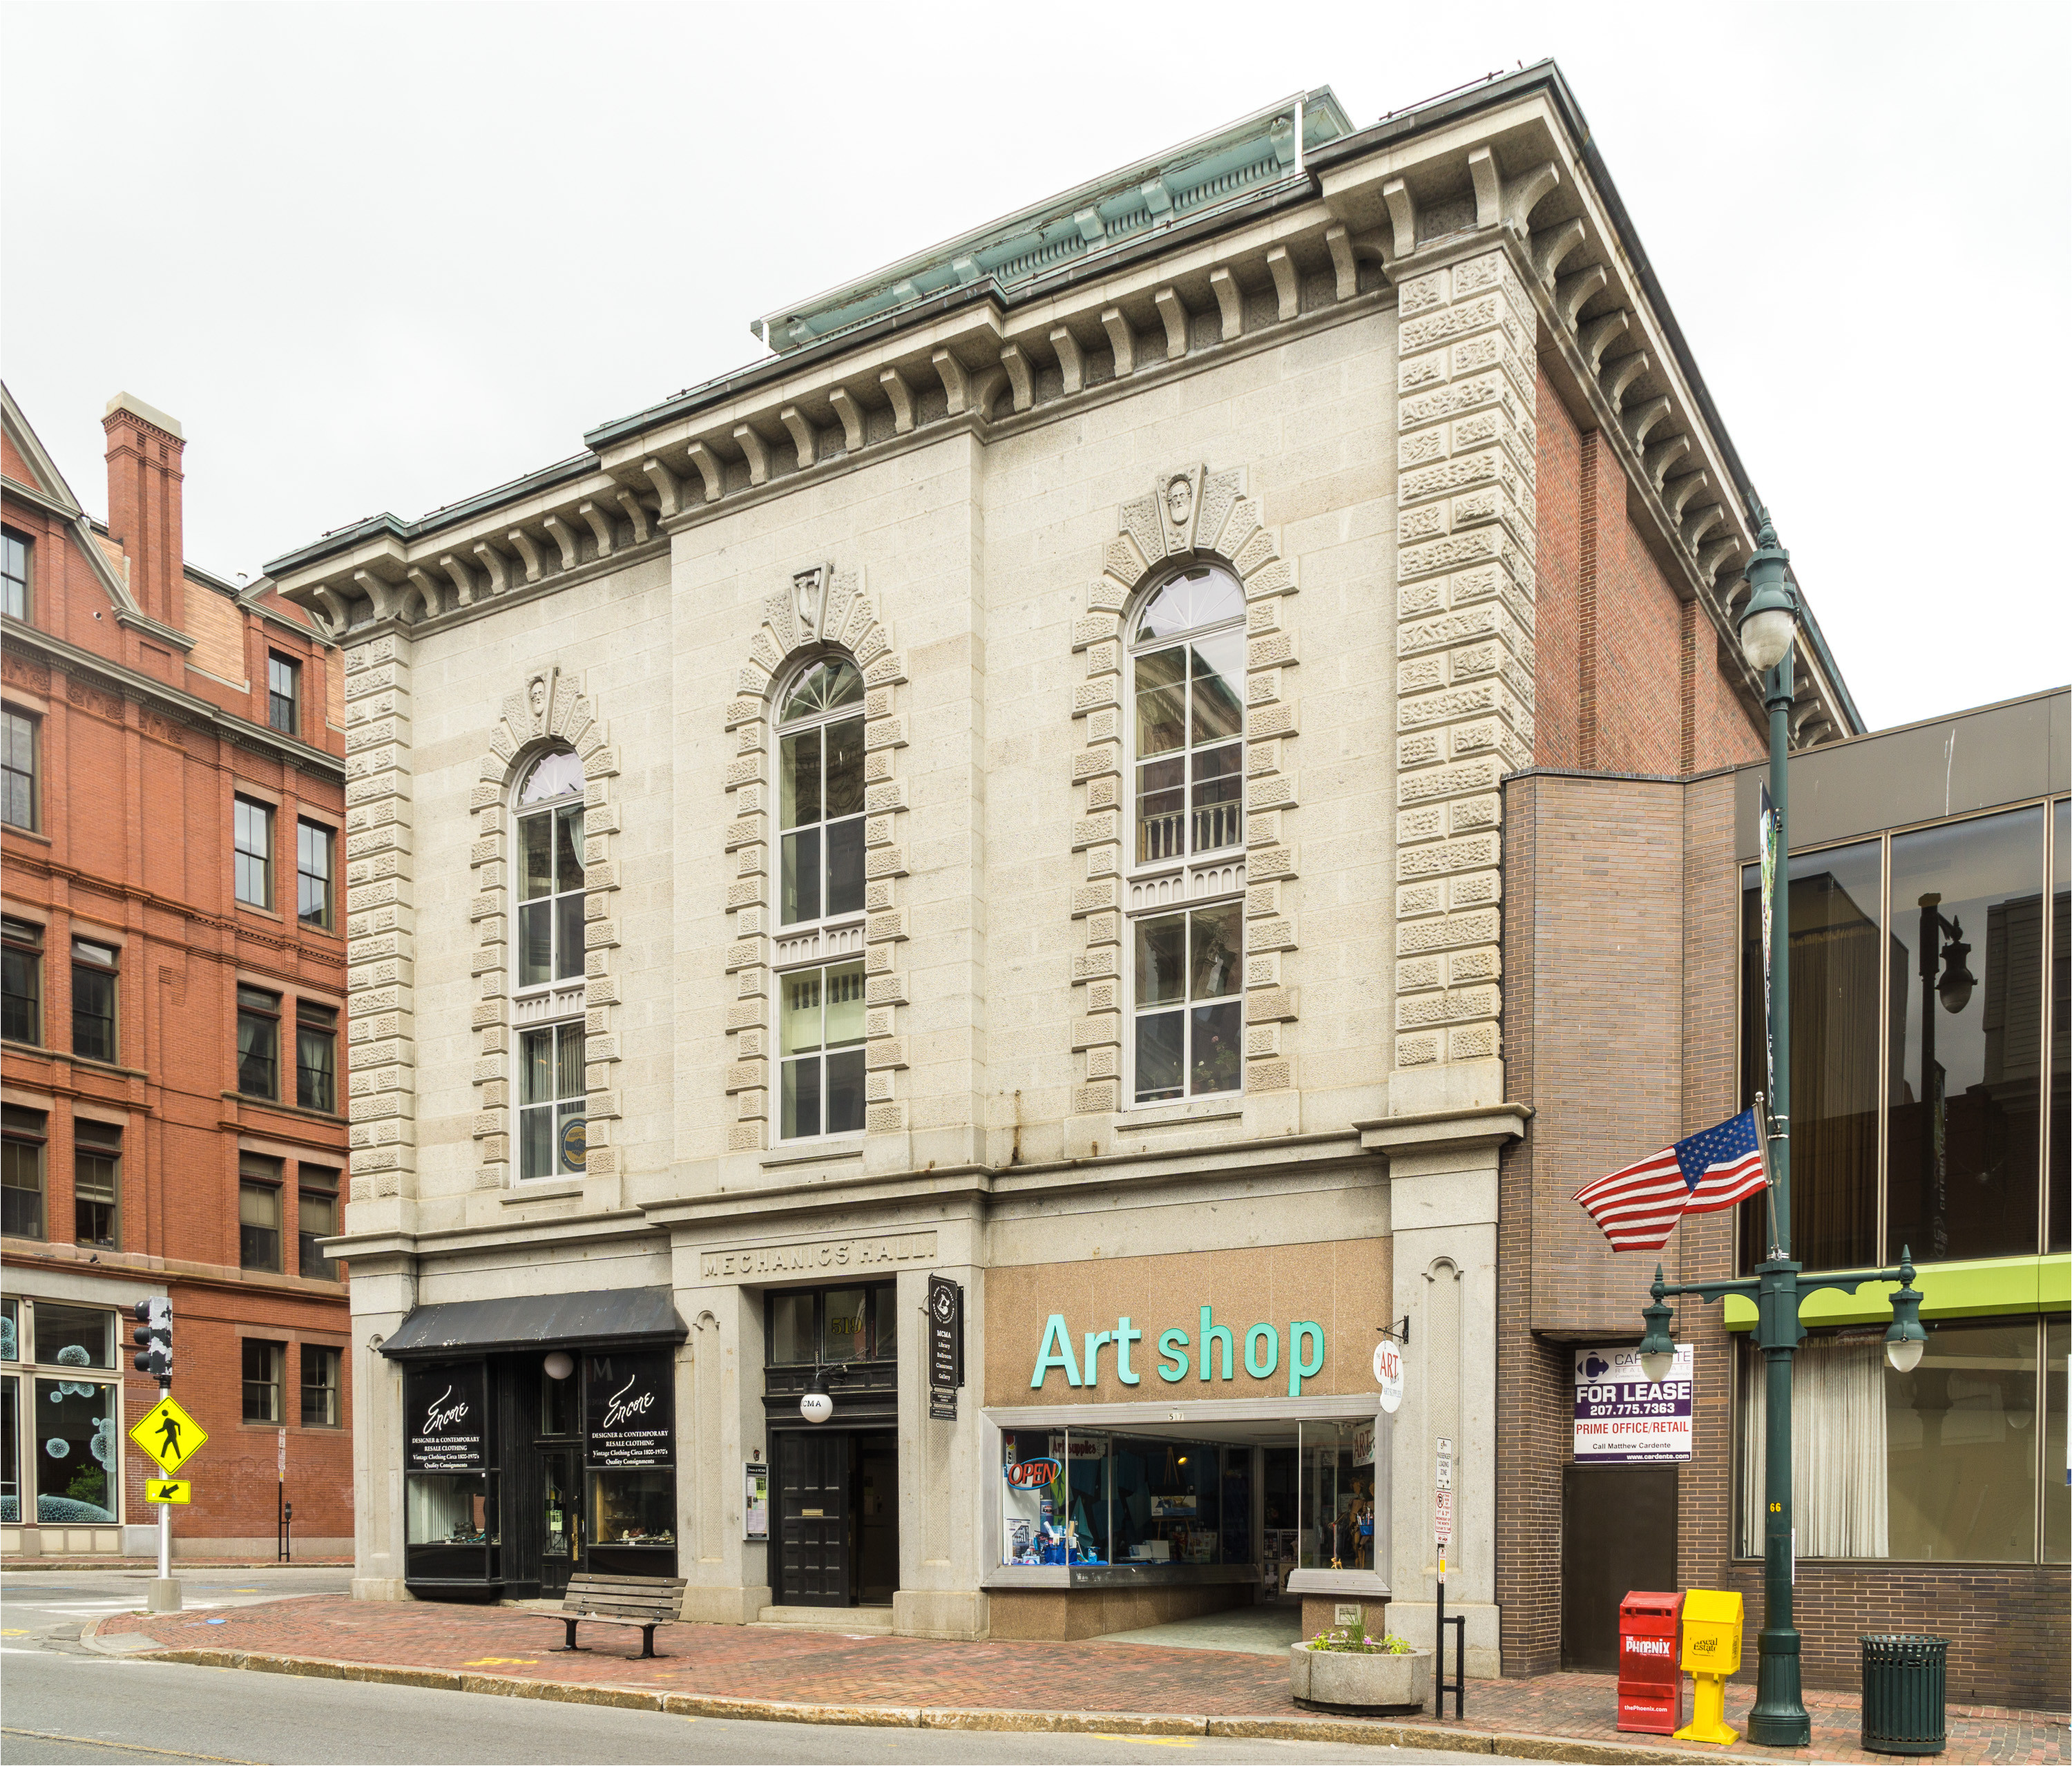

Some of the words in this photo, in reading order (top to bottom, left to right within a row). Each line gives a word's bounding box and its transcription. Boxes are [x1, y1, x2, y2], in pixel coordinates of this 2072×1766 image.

[832, 1316, 863, 1335] 519
[937, 1330, 952, 1338] MCMA
[937, 1352, 952, 1360] Ballroom
[1030, 1314, 1142, 1388] Art
[1158, 1305, 1324, 1397] shop
[1380, 1351, 1399, 1379] ART
[939, 1373, 950, 1381] Gallery
[603, 1374, 655, 1428] Encore
[1576, 1385, 1616, 1403] FOR
[1623, 1382, 1691, 1402] LEASE
[423, 1385, 469, 1434] Encore
[1590, 1403, 1675, 1416] 207.775.7363
[1576, 1423, 1609, 1434] PRIME
[1612, 1421, 1689, 1434] OFFICE/RETAIL
[1052, 1439, 1065, 1453] Art
[1068, 1440, 1097, 1457] supplies
[1353, 1430, 1371, 1460] ART
[1008, 1463, 1057, 1484] OPEN
[1769, 1503, 1781, 1513] 66
